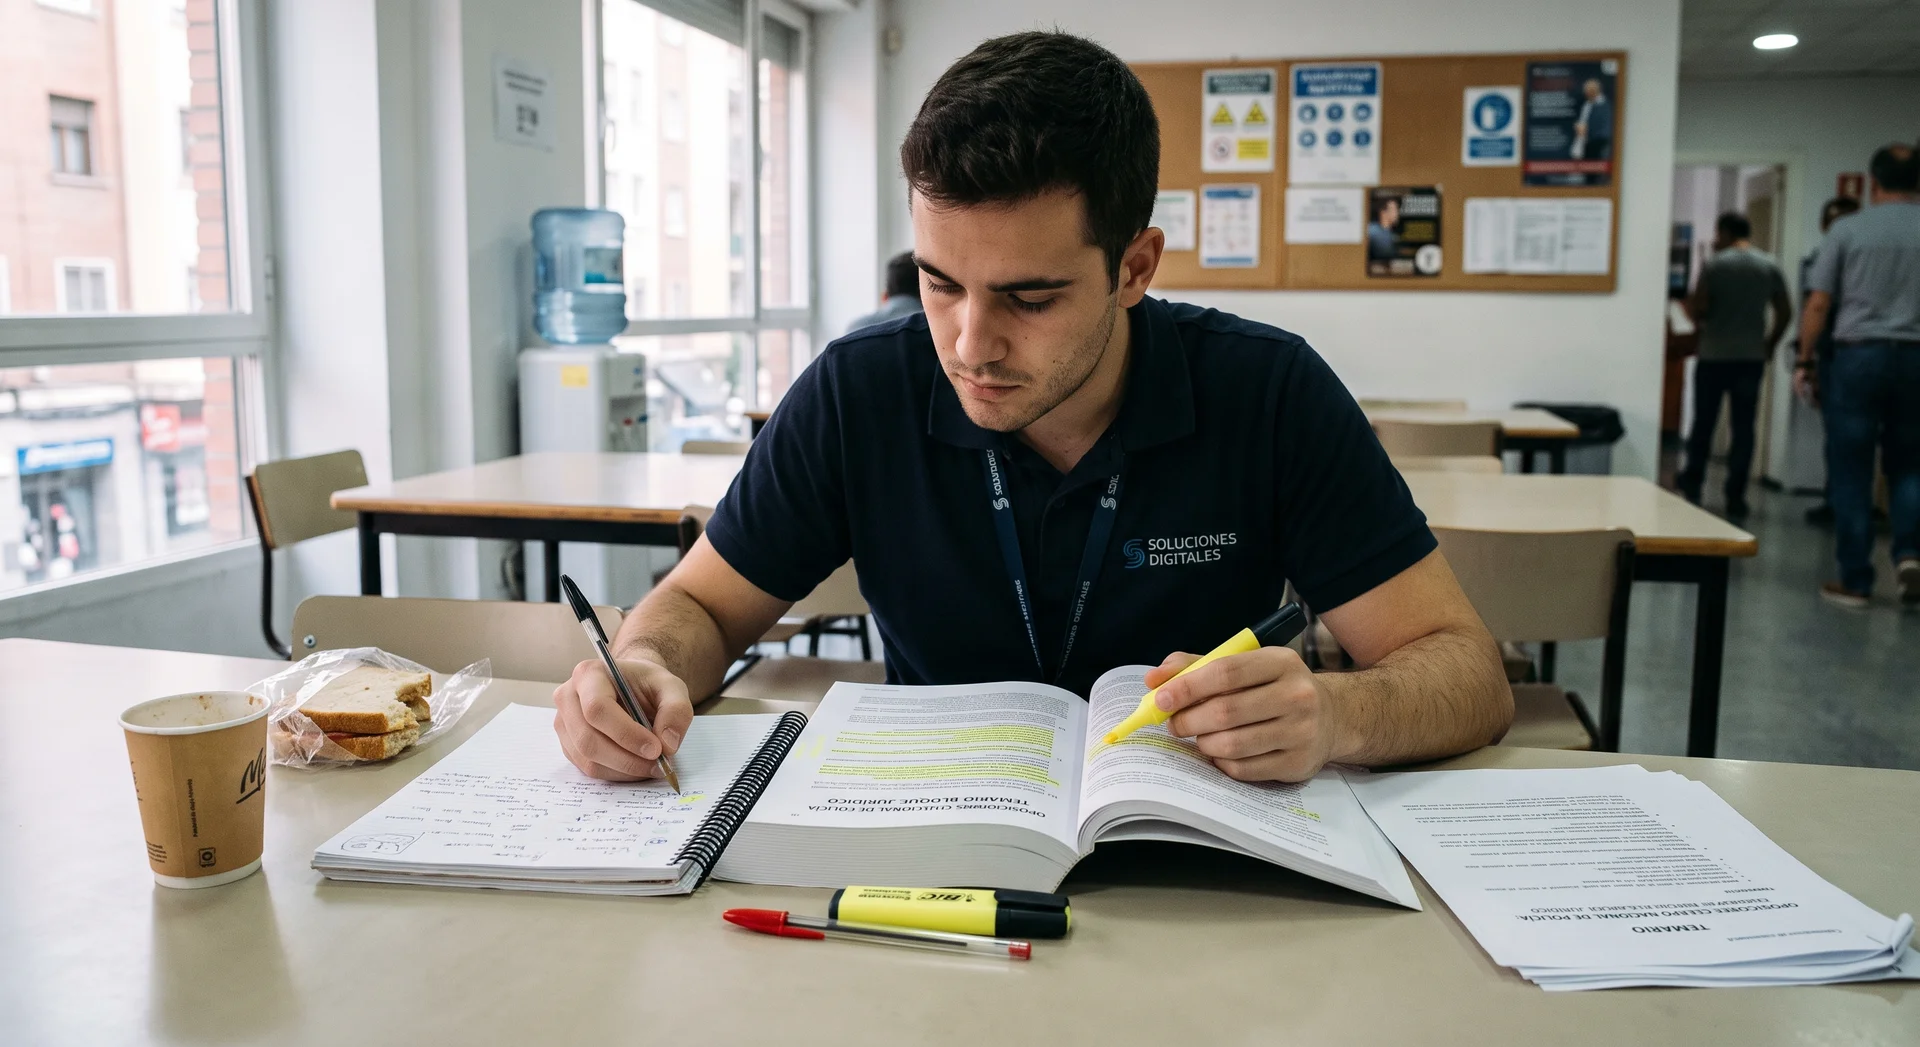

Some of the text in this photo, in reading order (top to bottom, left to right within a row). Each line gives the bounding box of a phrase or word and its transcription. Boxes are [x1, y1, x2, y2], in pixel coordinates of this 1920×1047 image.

[1148, 532, 1237, 551] SOLUCIONES
[1149, 548, 1221, 567] DIGITALES
[827, 796, 896, 806] JURÍDICO
[858, 805, 874, 813] DE
[920, 892, 963, 902] BIC
[1575, 912, 1591, 921] DE
[1597, 910, 1660, 921] NACIONAL
[1631, 923, 1711, 934] TEMARIO
